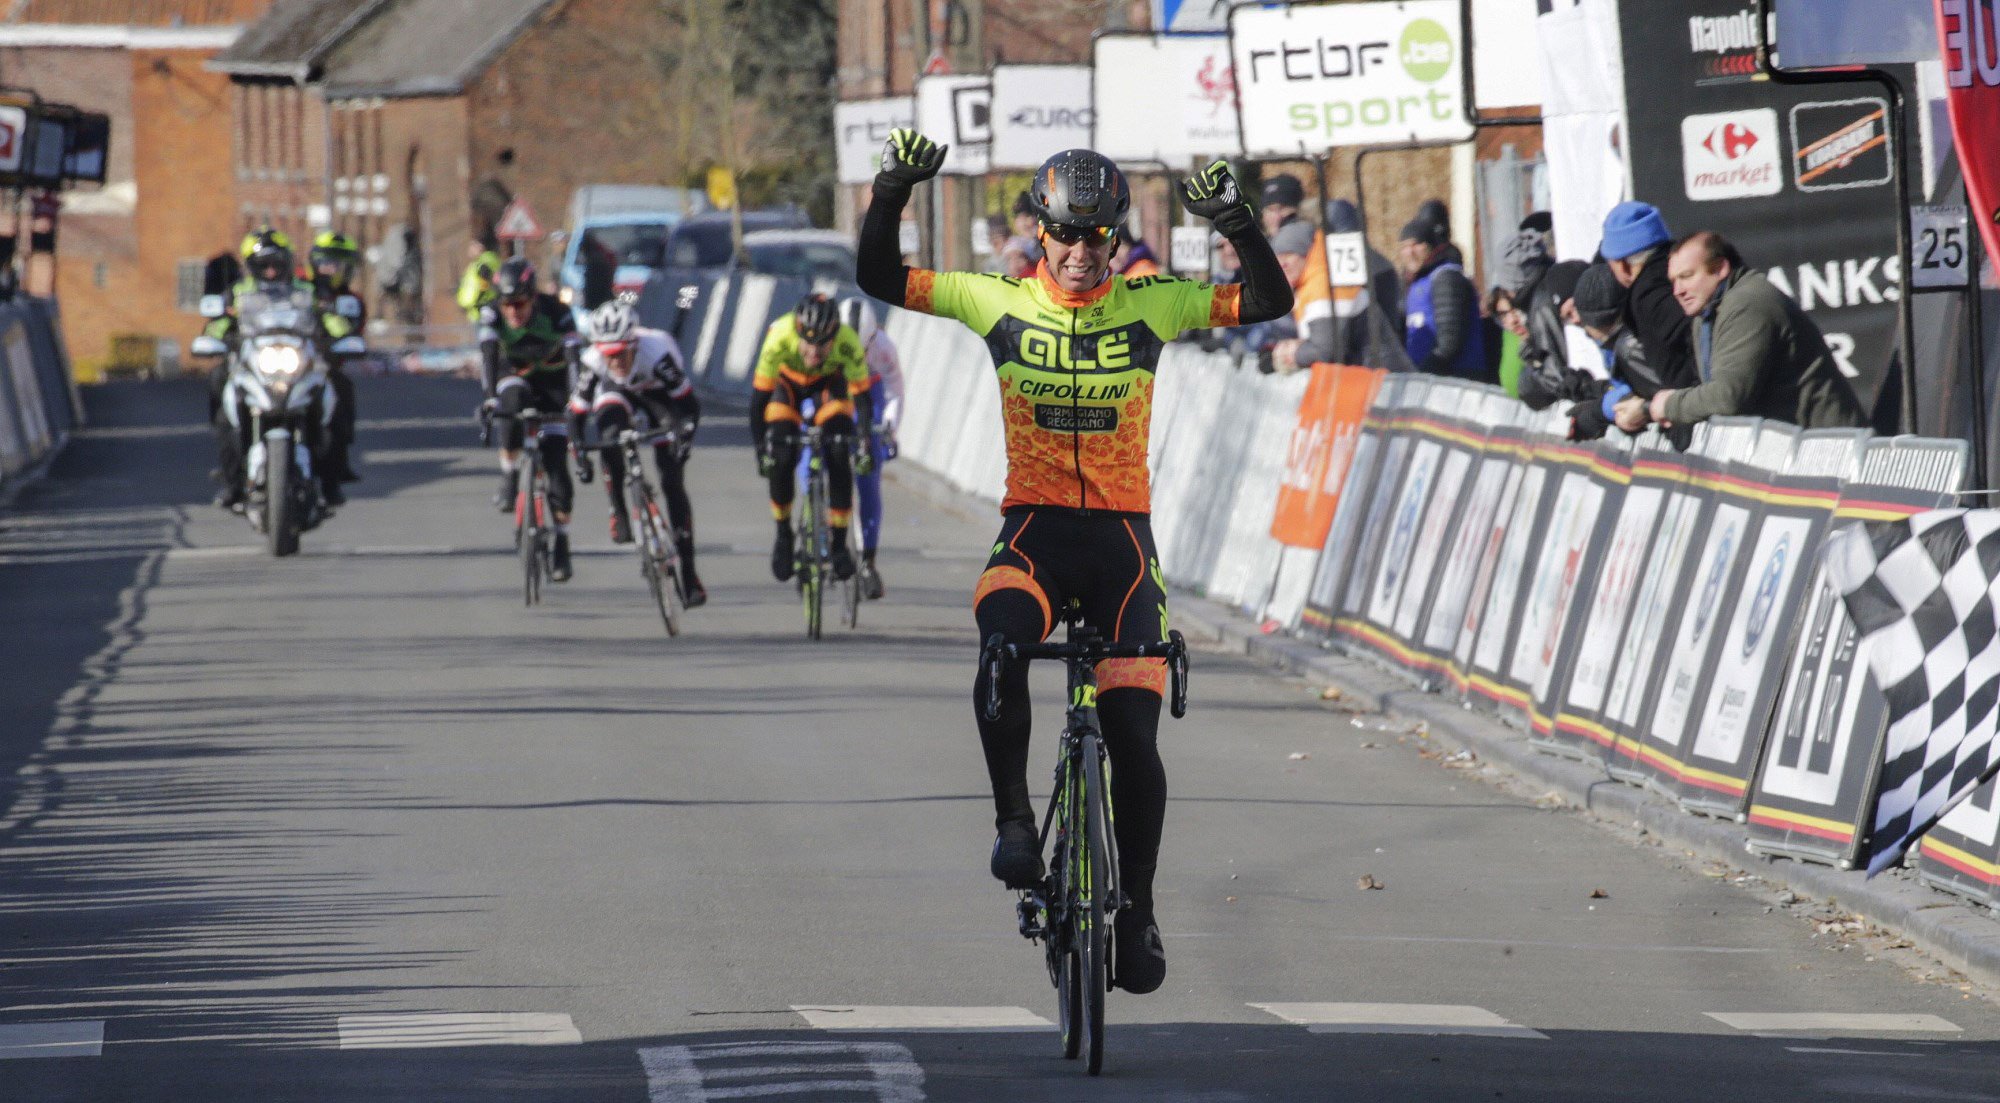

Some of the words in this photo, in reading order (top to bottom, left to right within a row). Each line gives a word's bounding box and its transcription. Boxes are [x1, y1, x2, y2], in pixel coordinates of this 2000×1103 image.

[1288, 88, 1453, 138] sport
[1693, 162, 1773, 188] market
[1334, 248, 1359, 273] 75
[1920, 227, 1962, 269] 25
[1019, 379, 1131, 400] CIPOLLINI
[1040, 406, 1112, 419] PARMIGIANO
[1047, 417, 1105, 428] REGGIANO
